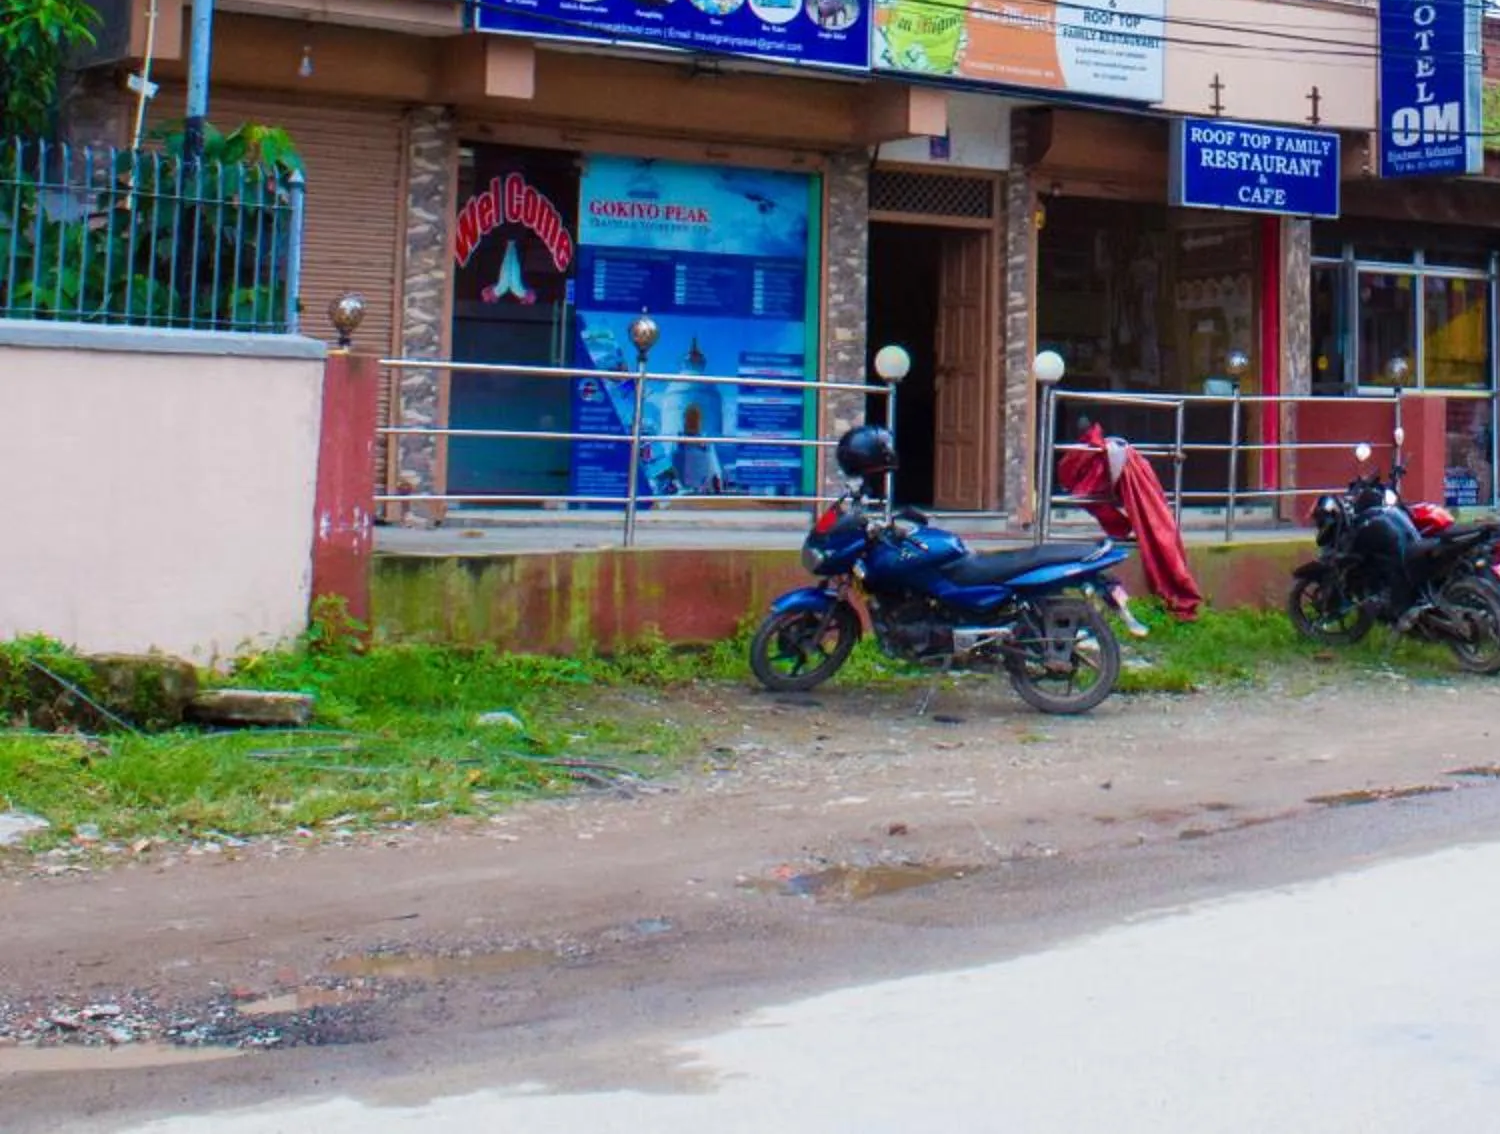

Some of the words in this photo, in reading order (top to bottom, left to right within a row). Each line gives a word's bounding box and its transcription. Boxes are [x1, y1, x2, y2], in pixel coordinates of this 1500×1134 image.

[1391, 101, 1460, 147] OM
[1190, 127, 1236, 146] ROOF
[1239, 130, 1271, 150] TOP
[1275, 134, 1332, 156] FAMILY
[1200, 147, 1323, 178] RESTAURANT
[1258, 174, 1269, 184] &
[1238, 185, 1287, 207] CAFE
[590, 200, 660, 220] GOKIYO
[664, 204, 709, 224] PEAK
